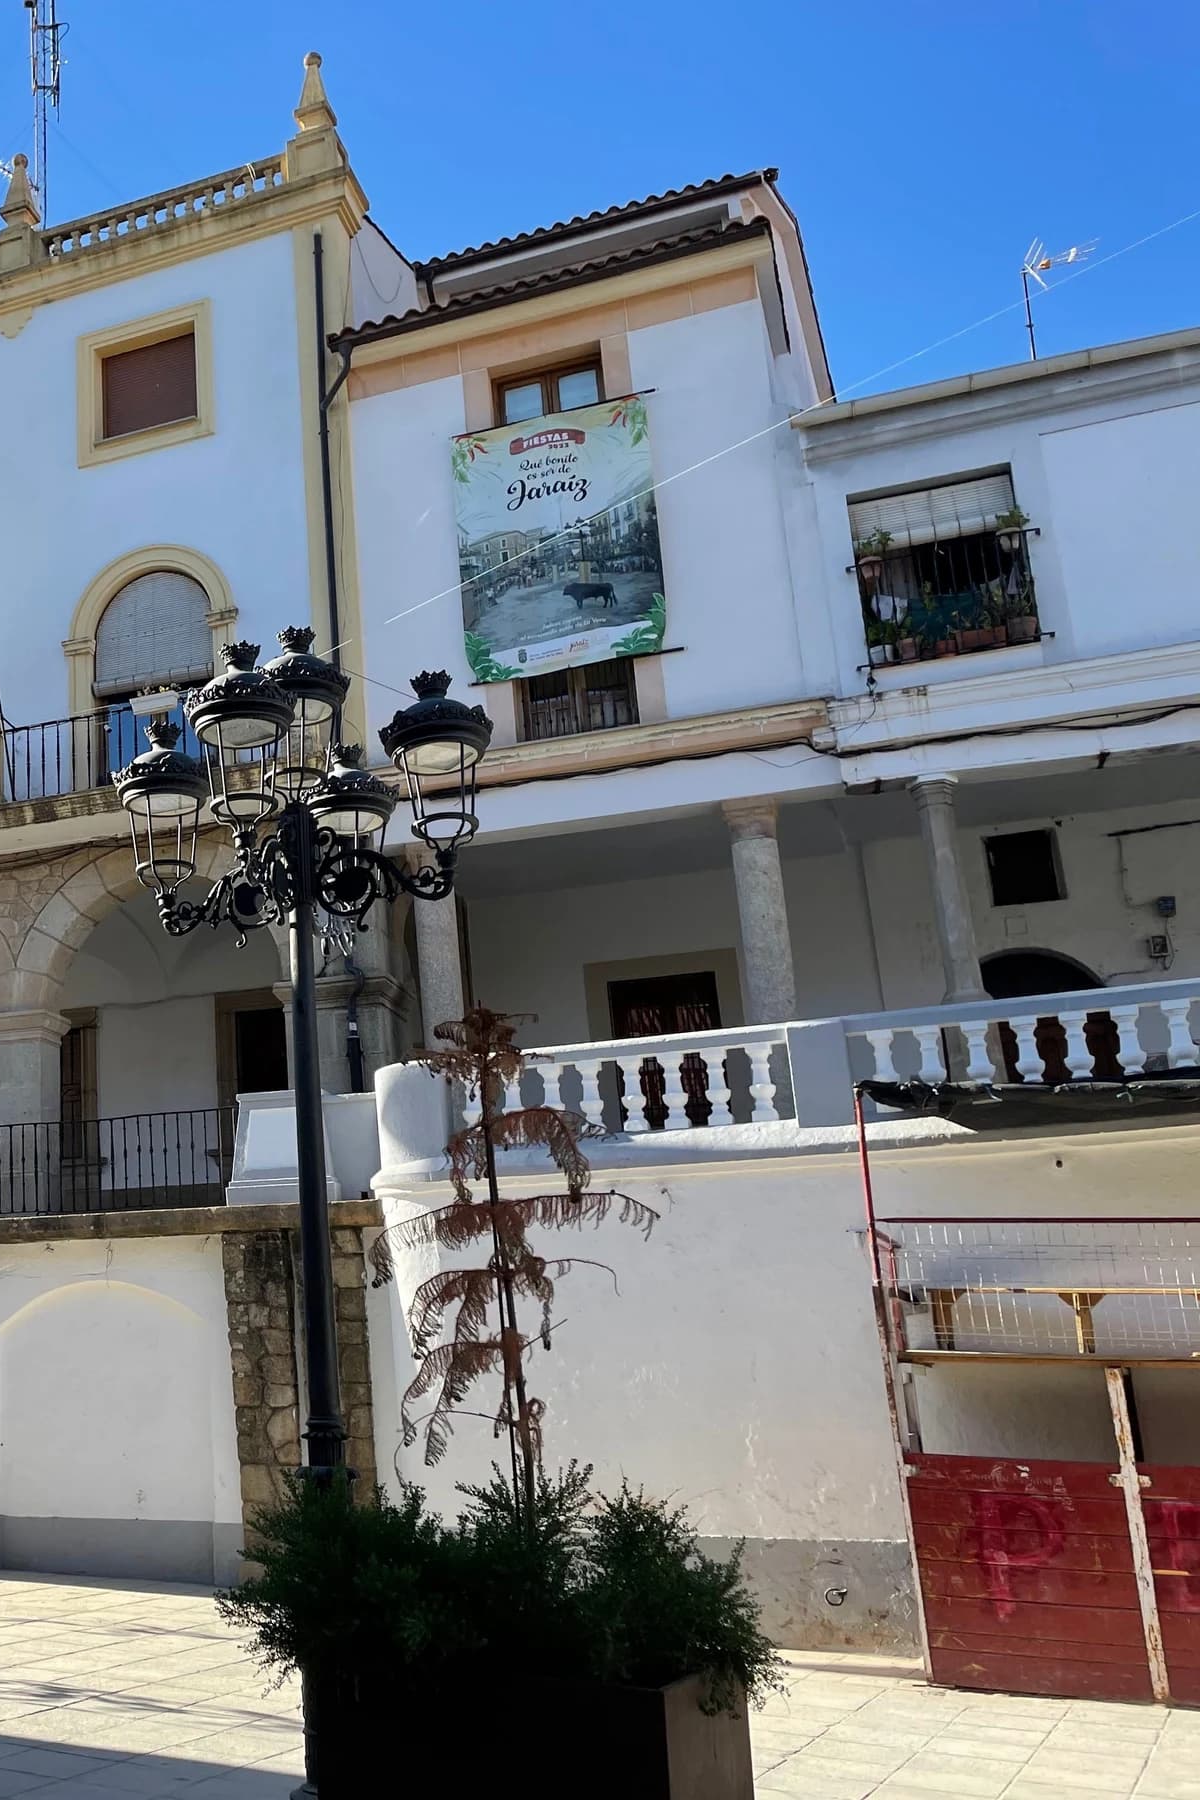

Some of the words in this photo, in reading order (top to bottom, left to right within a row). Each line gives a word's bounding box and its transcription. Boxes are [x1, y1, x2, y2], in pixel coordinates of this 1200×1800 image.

[523, 432, 569, 449] FIESTAS
[545, 452, 578, 466] bonito
[540, 468, 554, 478] ser
[558, 464, 571, 473] de
[506, 474, 592, 511] Jaraíz
